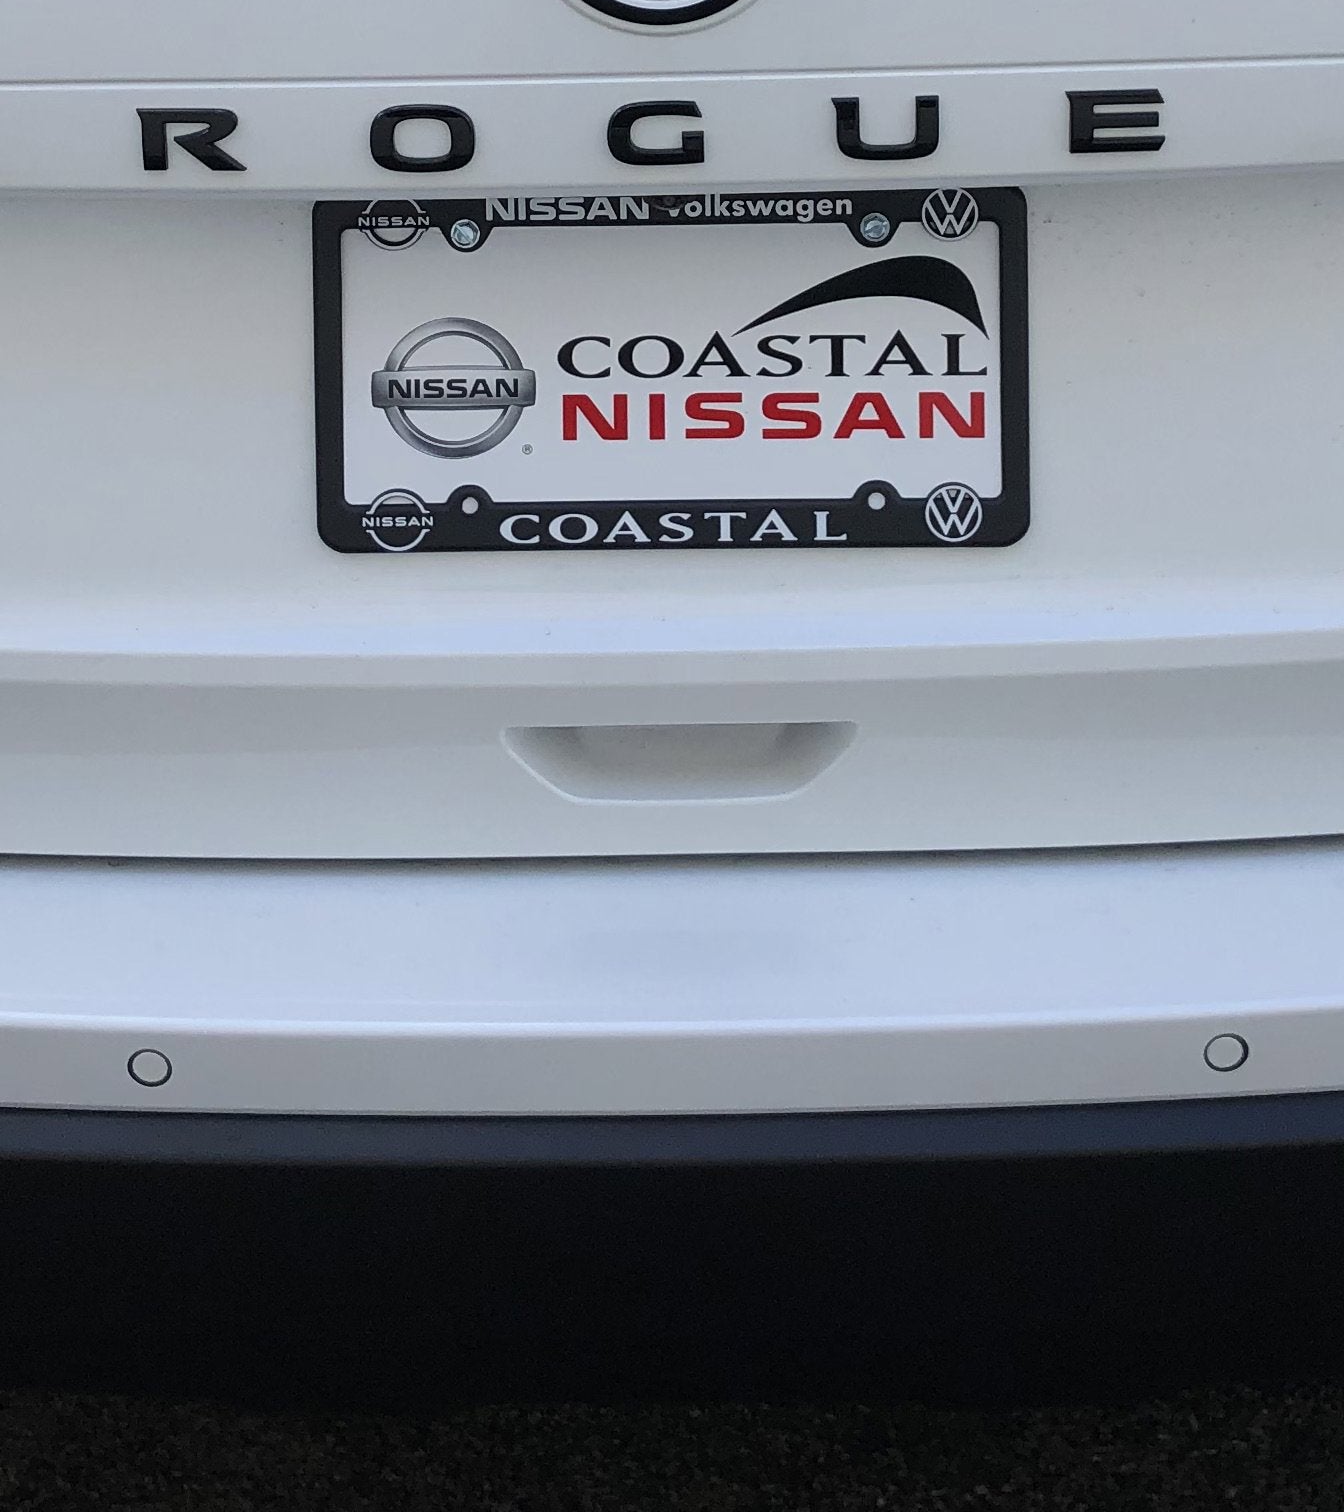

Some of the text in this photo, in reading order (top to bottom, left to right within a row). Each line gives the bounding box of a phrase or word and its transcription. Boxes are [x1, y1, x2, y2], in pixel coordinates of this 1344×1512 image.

[136, 88, 1166, 172] ROGUE
[358, 215, 431, 227] NISSAN
[485, 196, 650, 221] NISSAN
[557, 329, 988, 378] COASTAL
[388, 378, 519, 399] NISSAN
[562, 392, 986, 441] NISSAN
[362, 514, 434, 527] NISSAN
[499, 508, 848, 544] COASTAL
